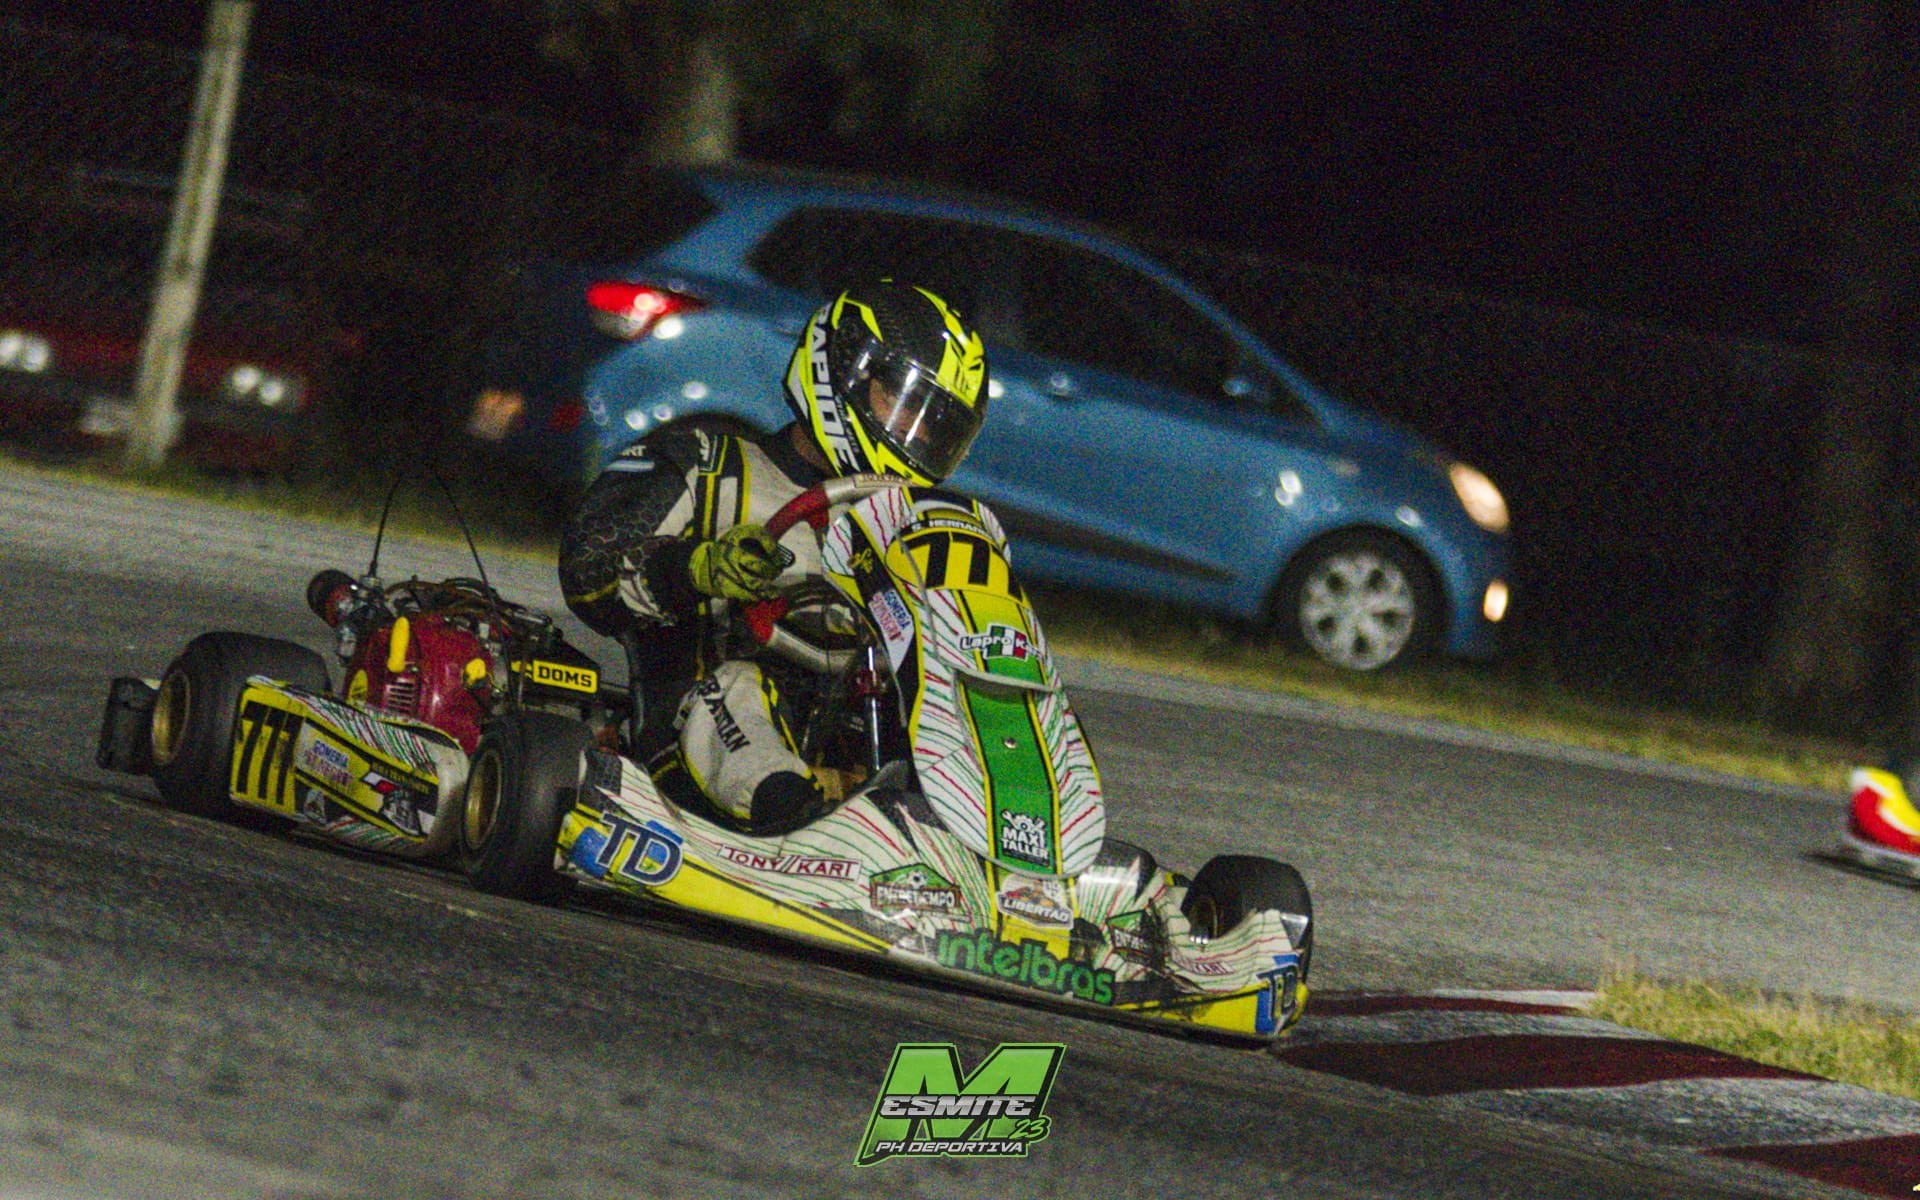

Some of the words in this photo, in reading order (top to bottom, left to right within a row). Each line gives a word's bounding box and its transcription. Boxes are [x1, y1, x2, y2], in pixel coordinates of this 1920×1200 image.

[537, 664, 593, 688] DOMS
[596, 811, 683, 886] TD
[1000, 838, 1049, 860] TALLER
[1002, 826, 1045, 849] MAXI
[724, 847, 783, 870] TONY
[797, 859, 858, 877] KART
[1004, 897, 1069, 922] LIBERTAD
[937, 930, 1114, 1003] intelbras
